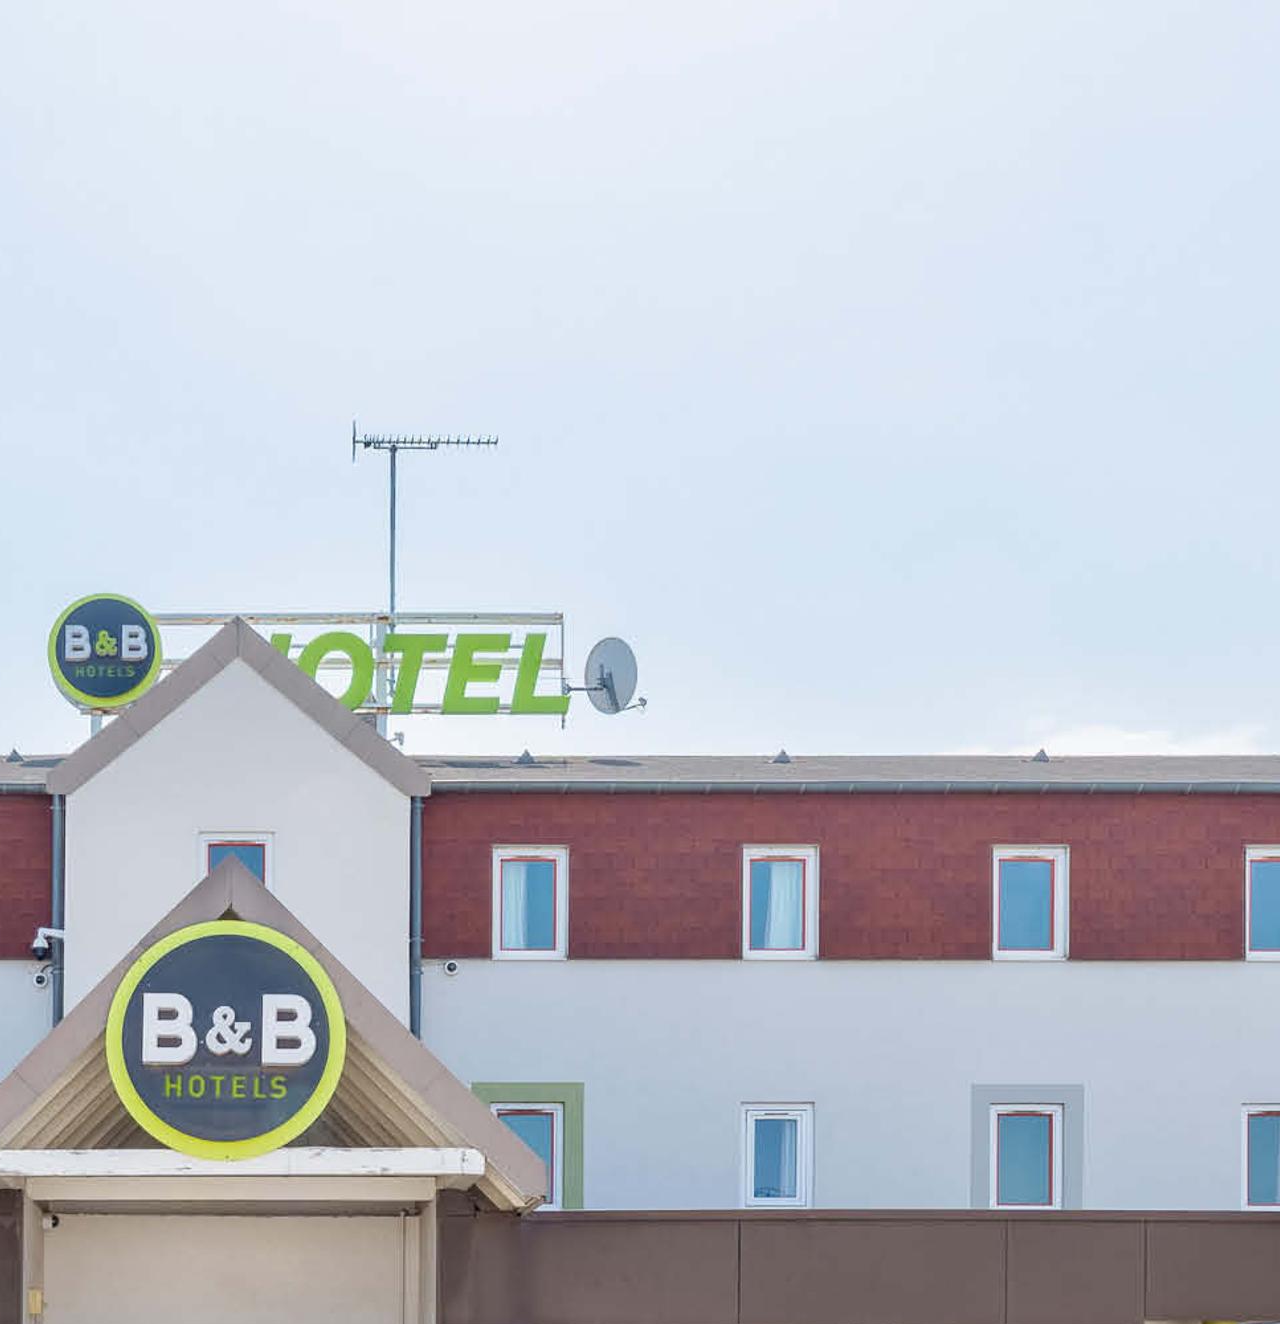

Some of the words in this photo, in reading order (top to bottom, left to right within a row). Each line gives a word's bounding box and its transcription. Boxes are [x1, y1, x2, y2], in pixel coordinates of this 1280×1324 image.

[65, 625, 148, 661] B&B
[75, 665, 136, 678] HOTELS
[270, 631, 571, 715] OTEL
[142, 992, 317, 1066] B&B
[164, 1074, 289, 1099] HOTELS
